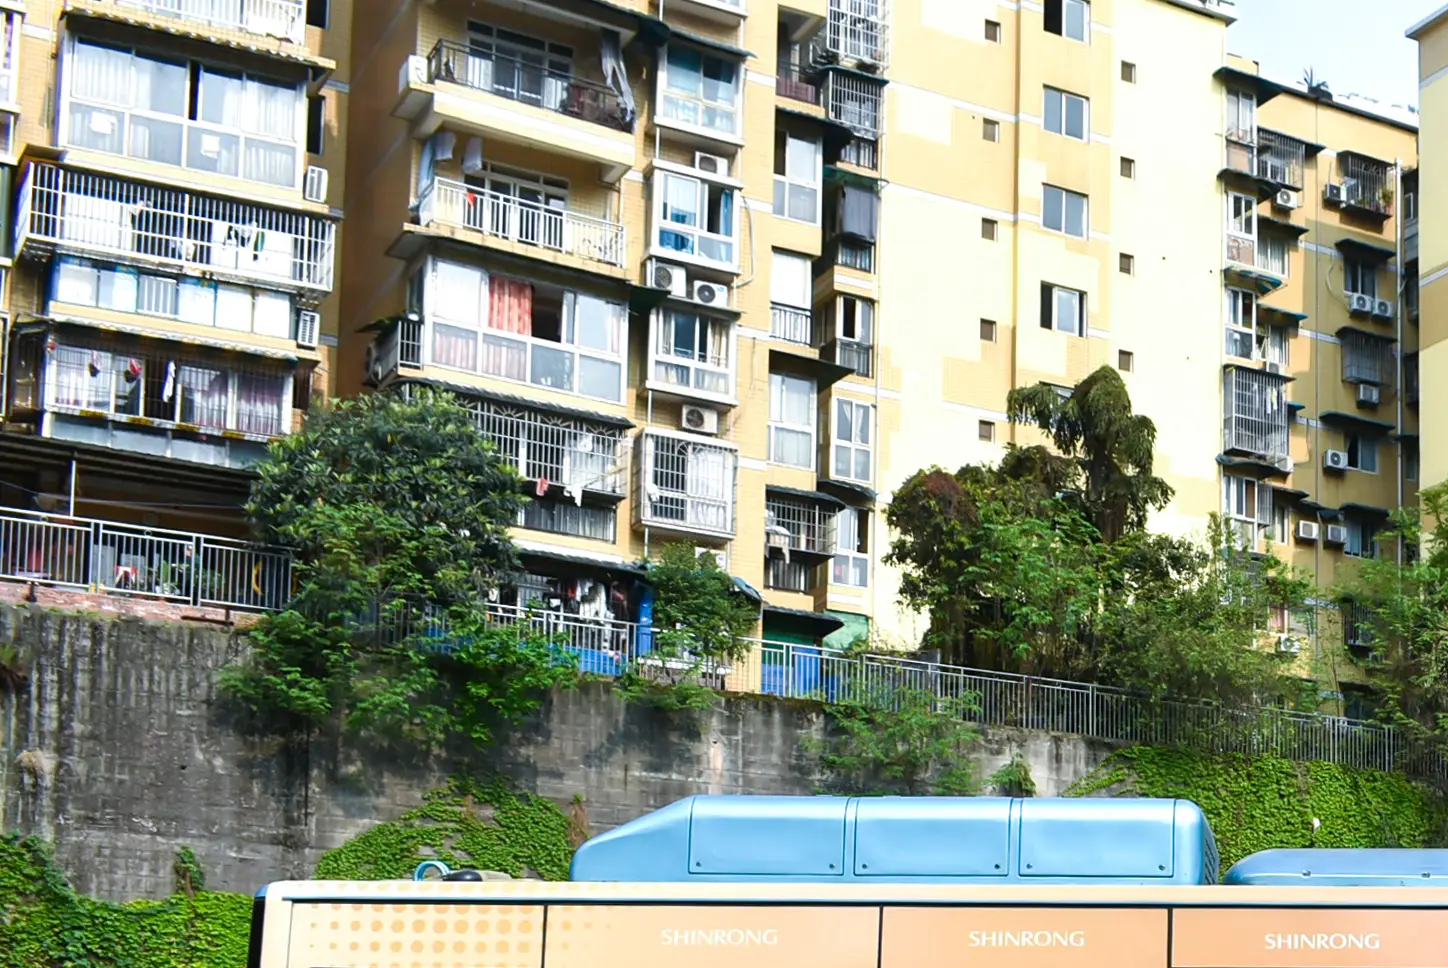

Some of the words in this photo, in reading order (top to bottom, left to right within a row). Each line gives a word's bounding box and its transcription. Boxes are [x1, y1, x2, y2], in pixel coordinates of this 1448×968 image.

[661, 928, 779, 946] SHINRONG
[968, 930, 1085, 947] SHINRONG
[1264, 933, 1380, 950] SHINRONG
